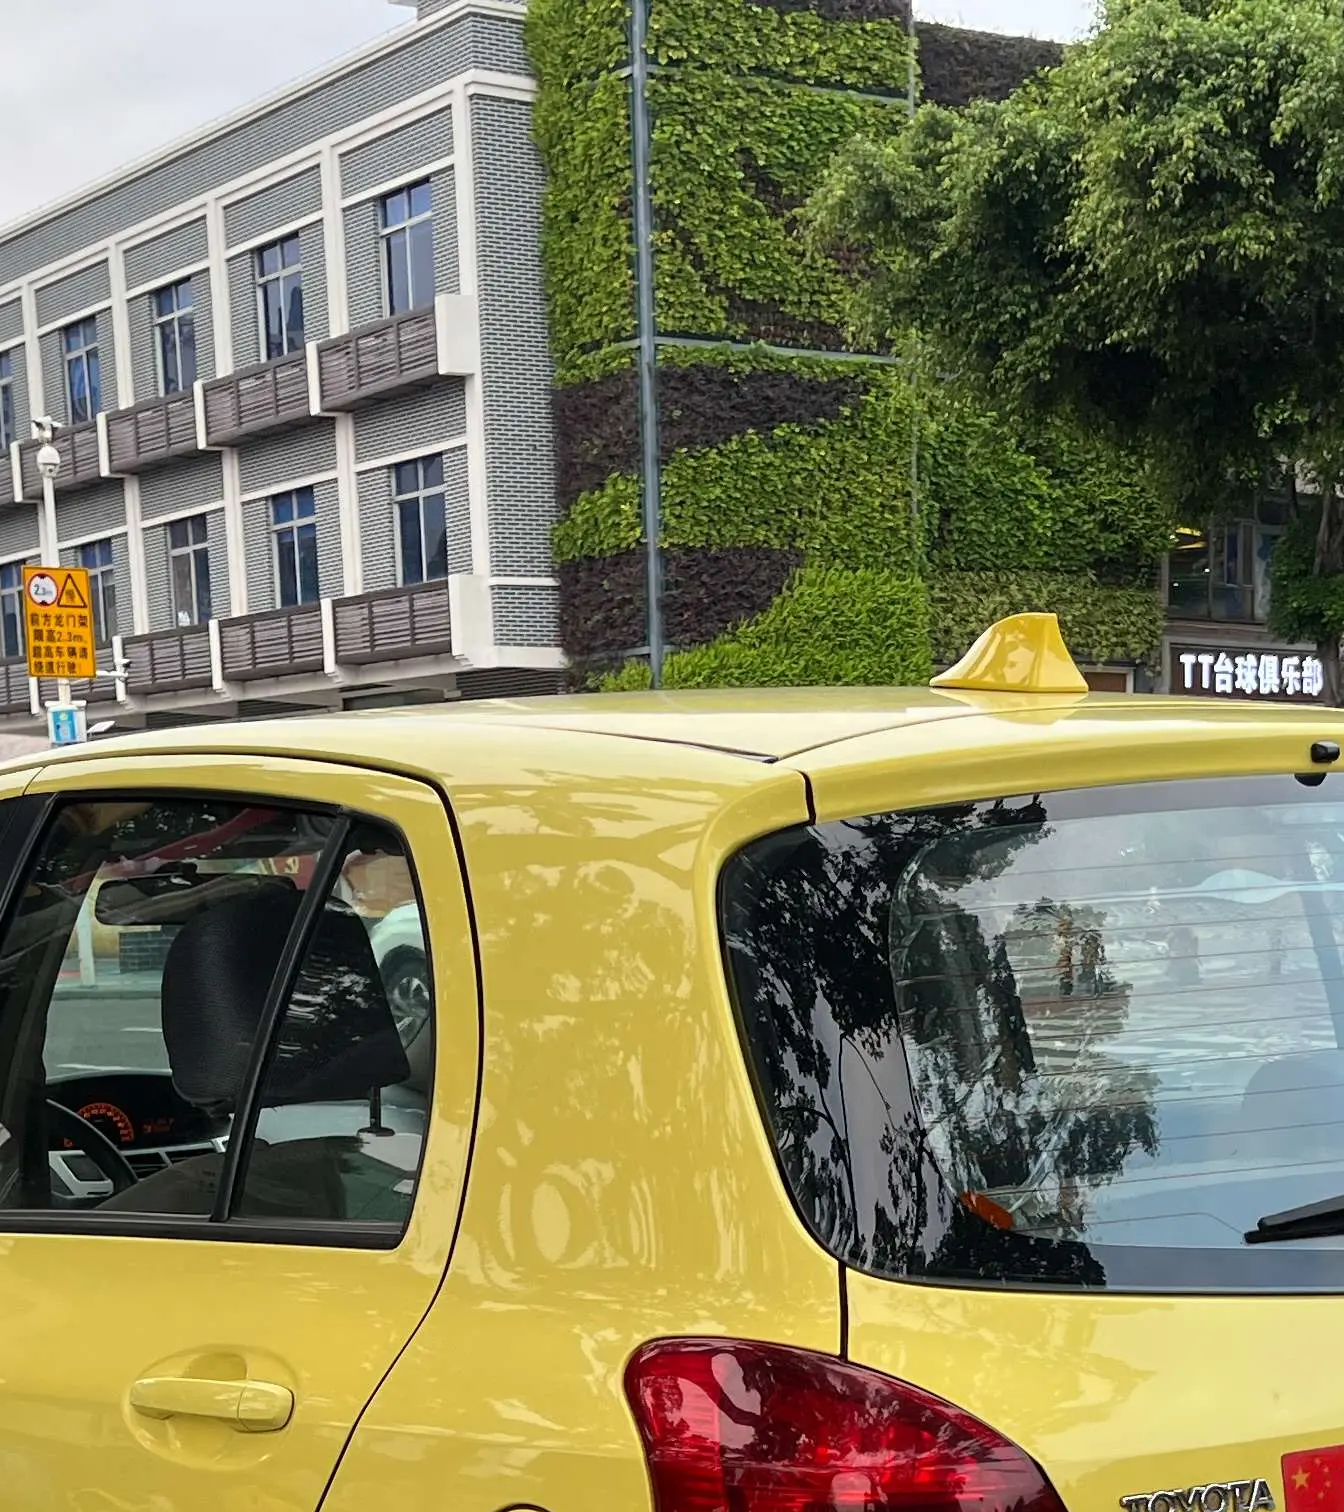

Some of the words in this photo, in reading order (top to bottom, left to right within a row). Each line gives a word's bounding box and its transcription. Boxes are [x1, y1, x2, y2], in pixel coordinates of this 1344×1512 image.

[31, 612, 88, 628] 前方龙门架
[1179, 652, 1324, 696] TT台球俱乐部
